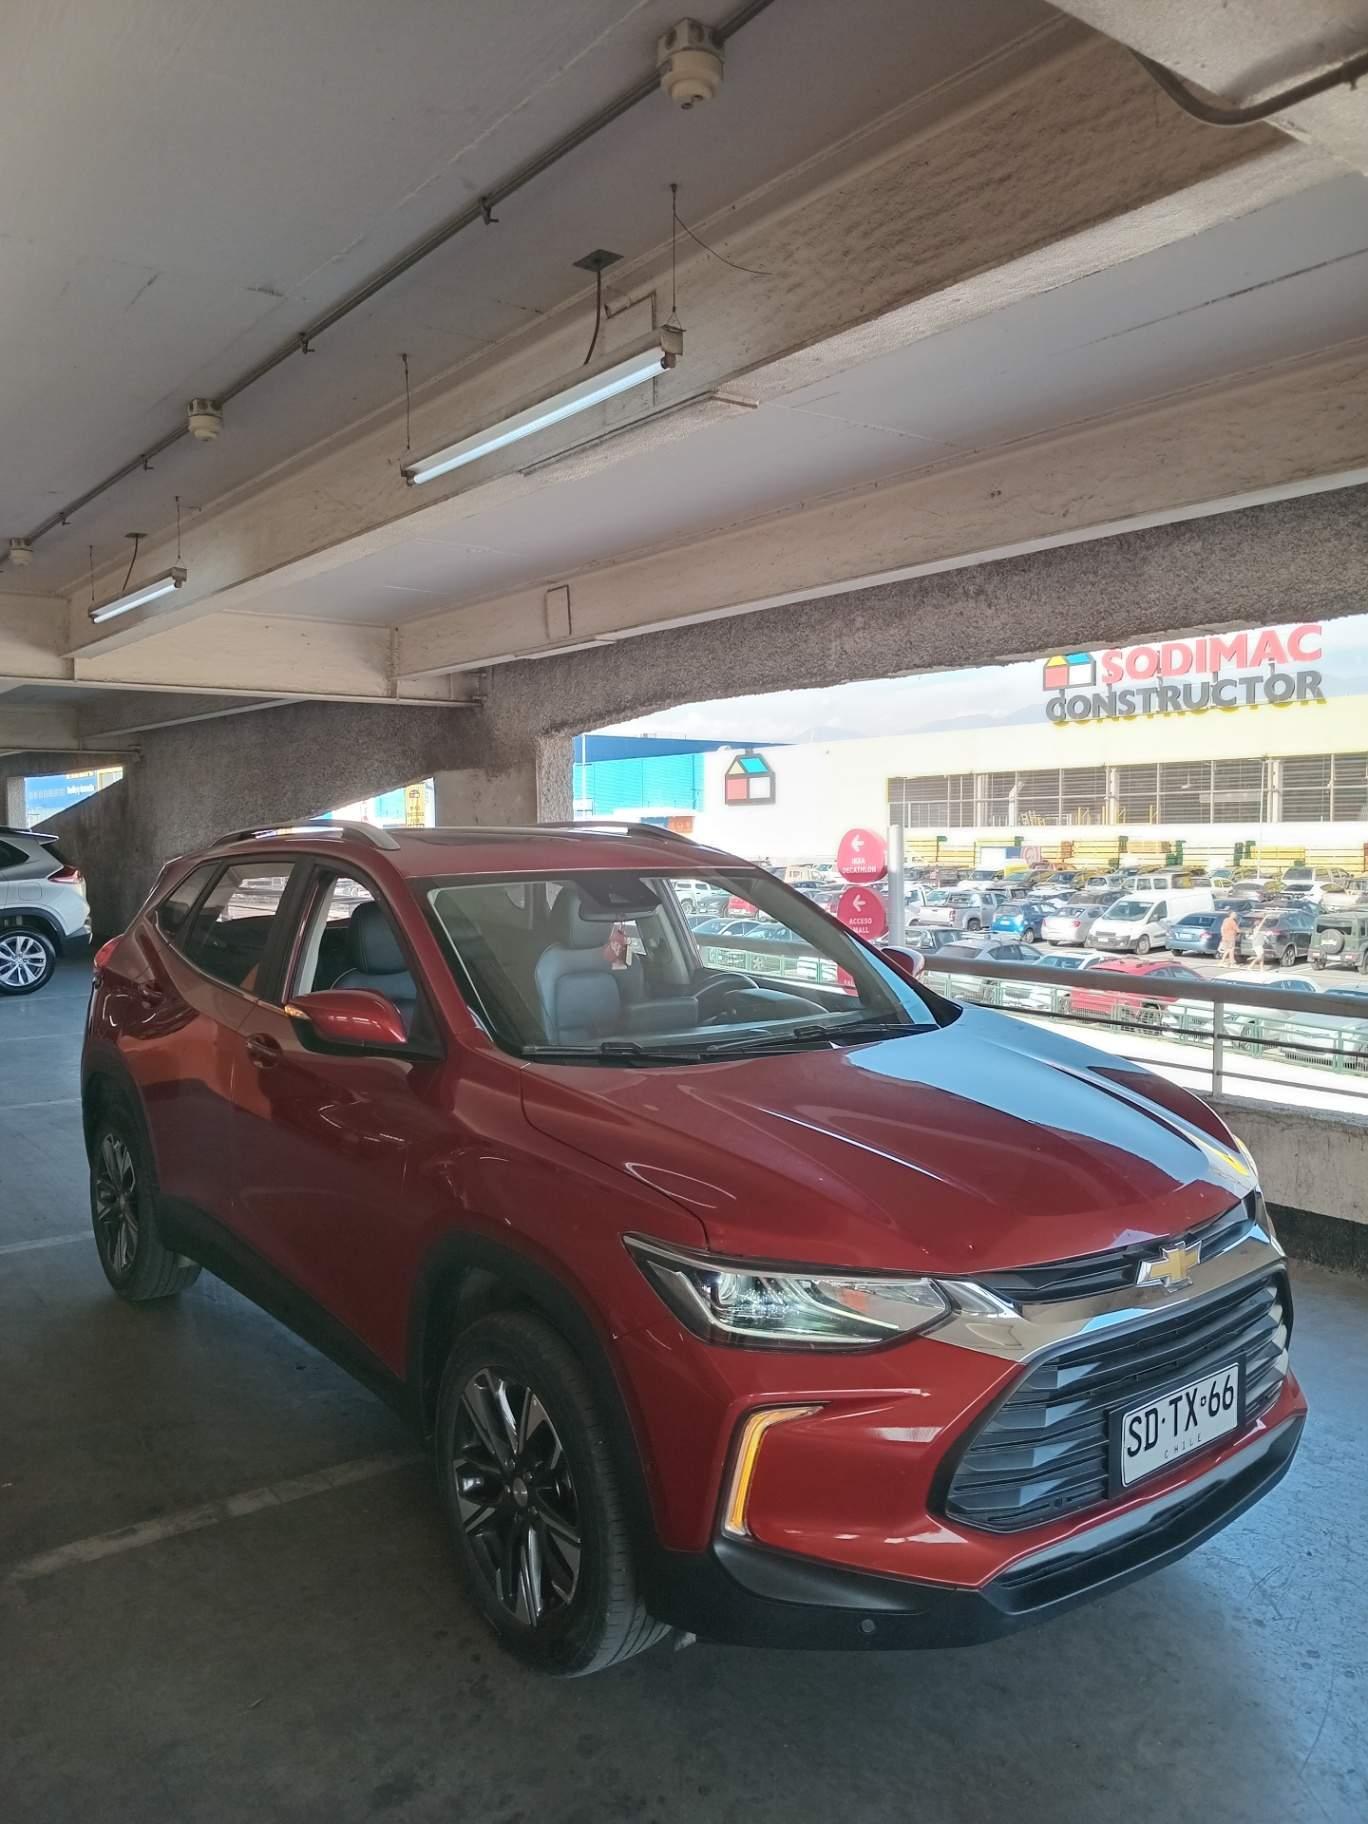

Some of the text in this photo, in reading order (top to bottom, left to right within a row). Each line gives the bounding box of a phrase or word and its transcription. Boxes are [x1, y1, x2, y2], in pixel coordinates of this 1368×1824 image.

[1101, 625, 1323, 685] SODIMAC
[1045, 670, 1325, 722] CONSTRUCTOR
[842, 865, 877, 874] DECATHLON
[849, 917, 873, 925] ACCESO
